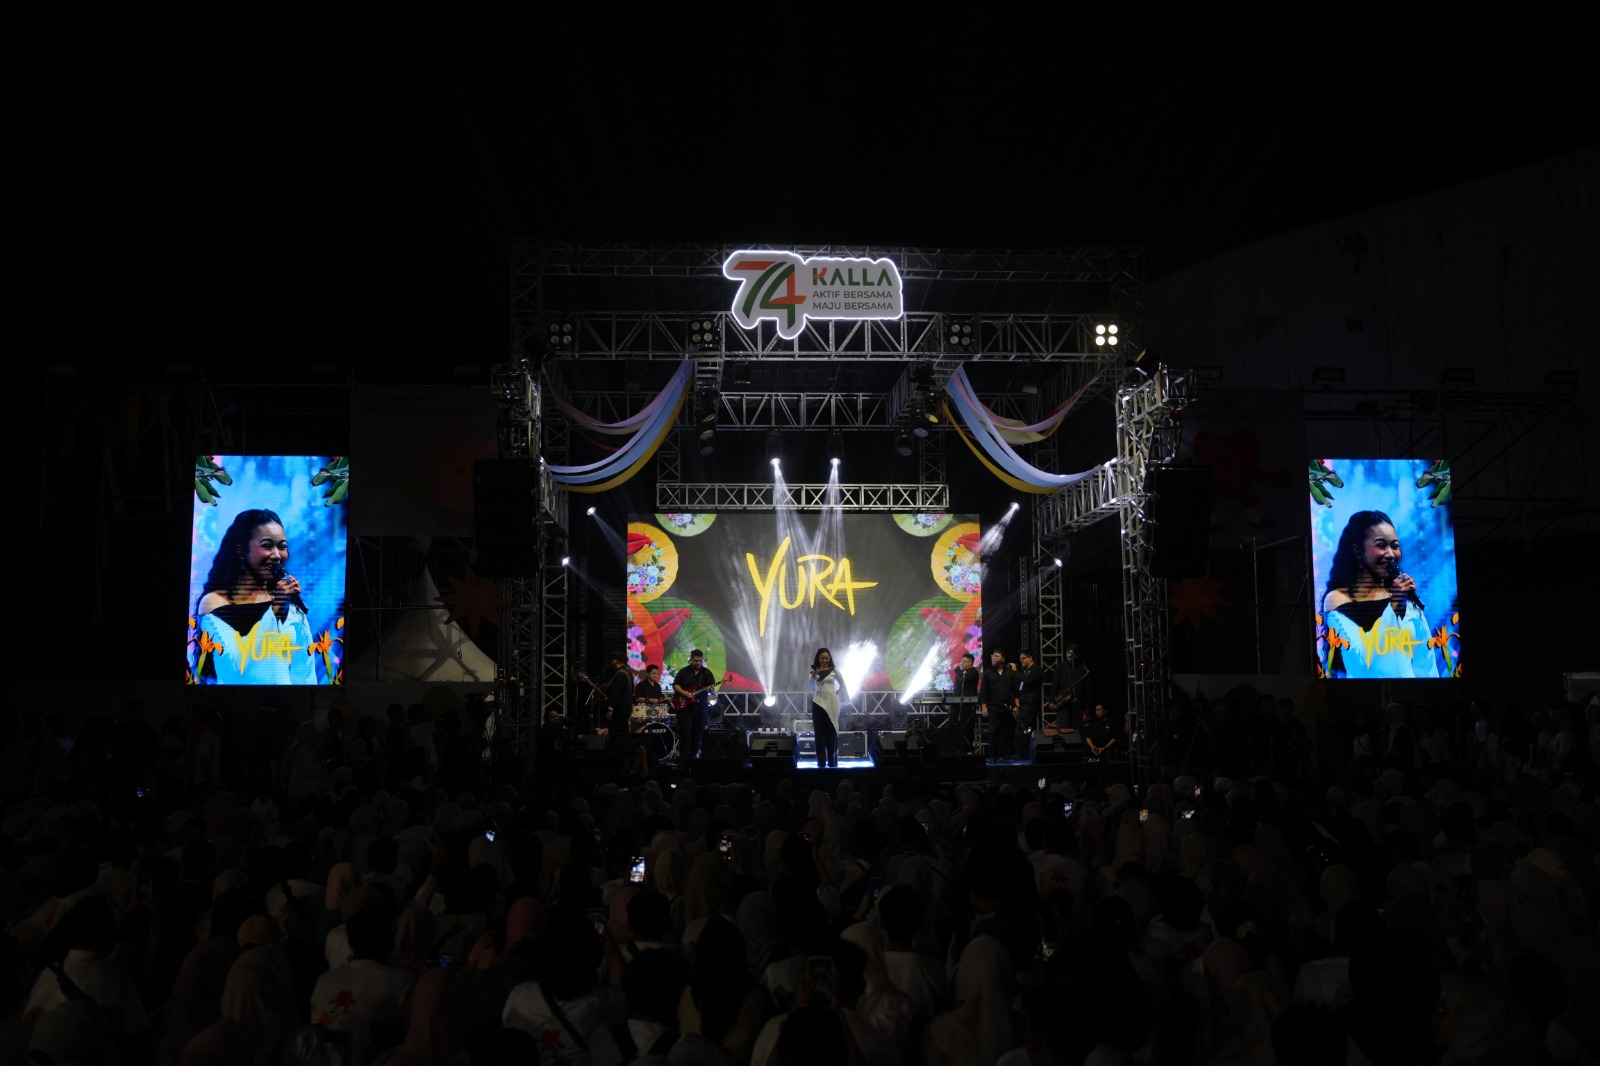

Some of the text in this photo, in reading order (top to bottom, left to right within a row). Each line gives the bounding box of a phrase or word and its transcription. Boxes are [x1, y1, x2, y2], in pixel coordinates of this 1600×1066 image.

[733, 261, 807, 330] 74
[812, 268, 893, 286] KALLA
[812, 290, 893, 299] AKTIF BERSAMA
[812, 302, 894, 310] MAJU BERSAMA
[746, 536, 879, 638] YURA
[235, 621, 304, 675] YURA
[1358, 617, 1424, 670] YURA
